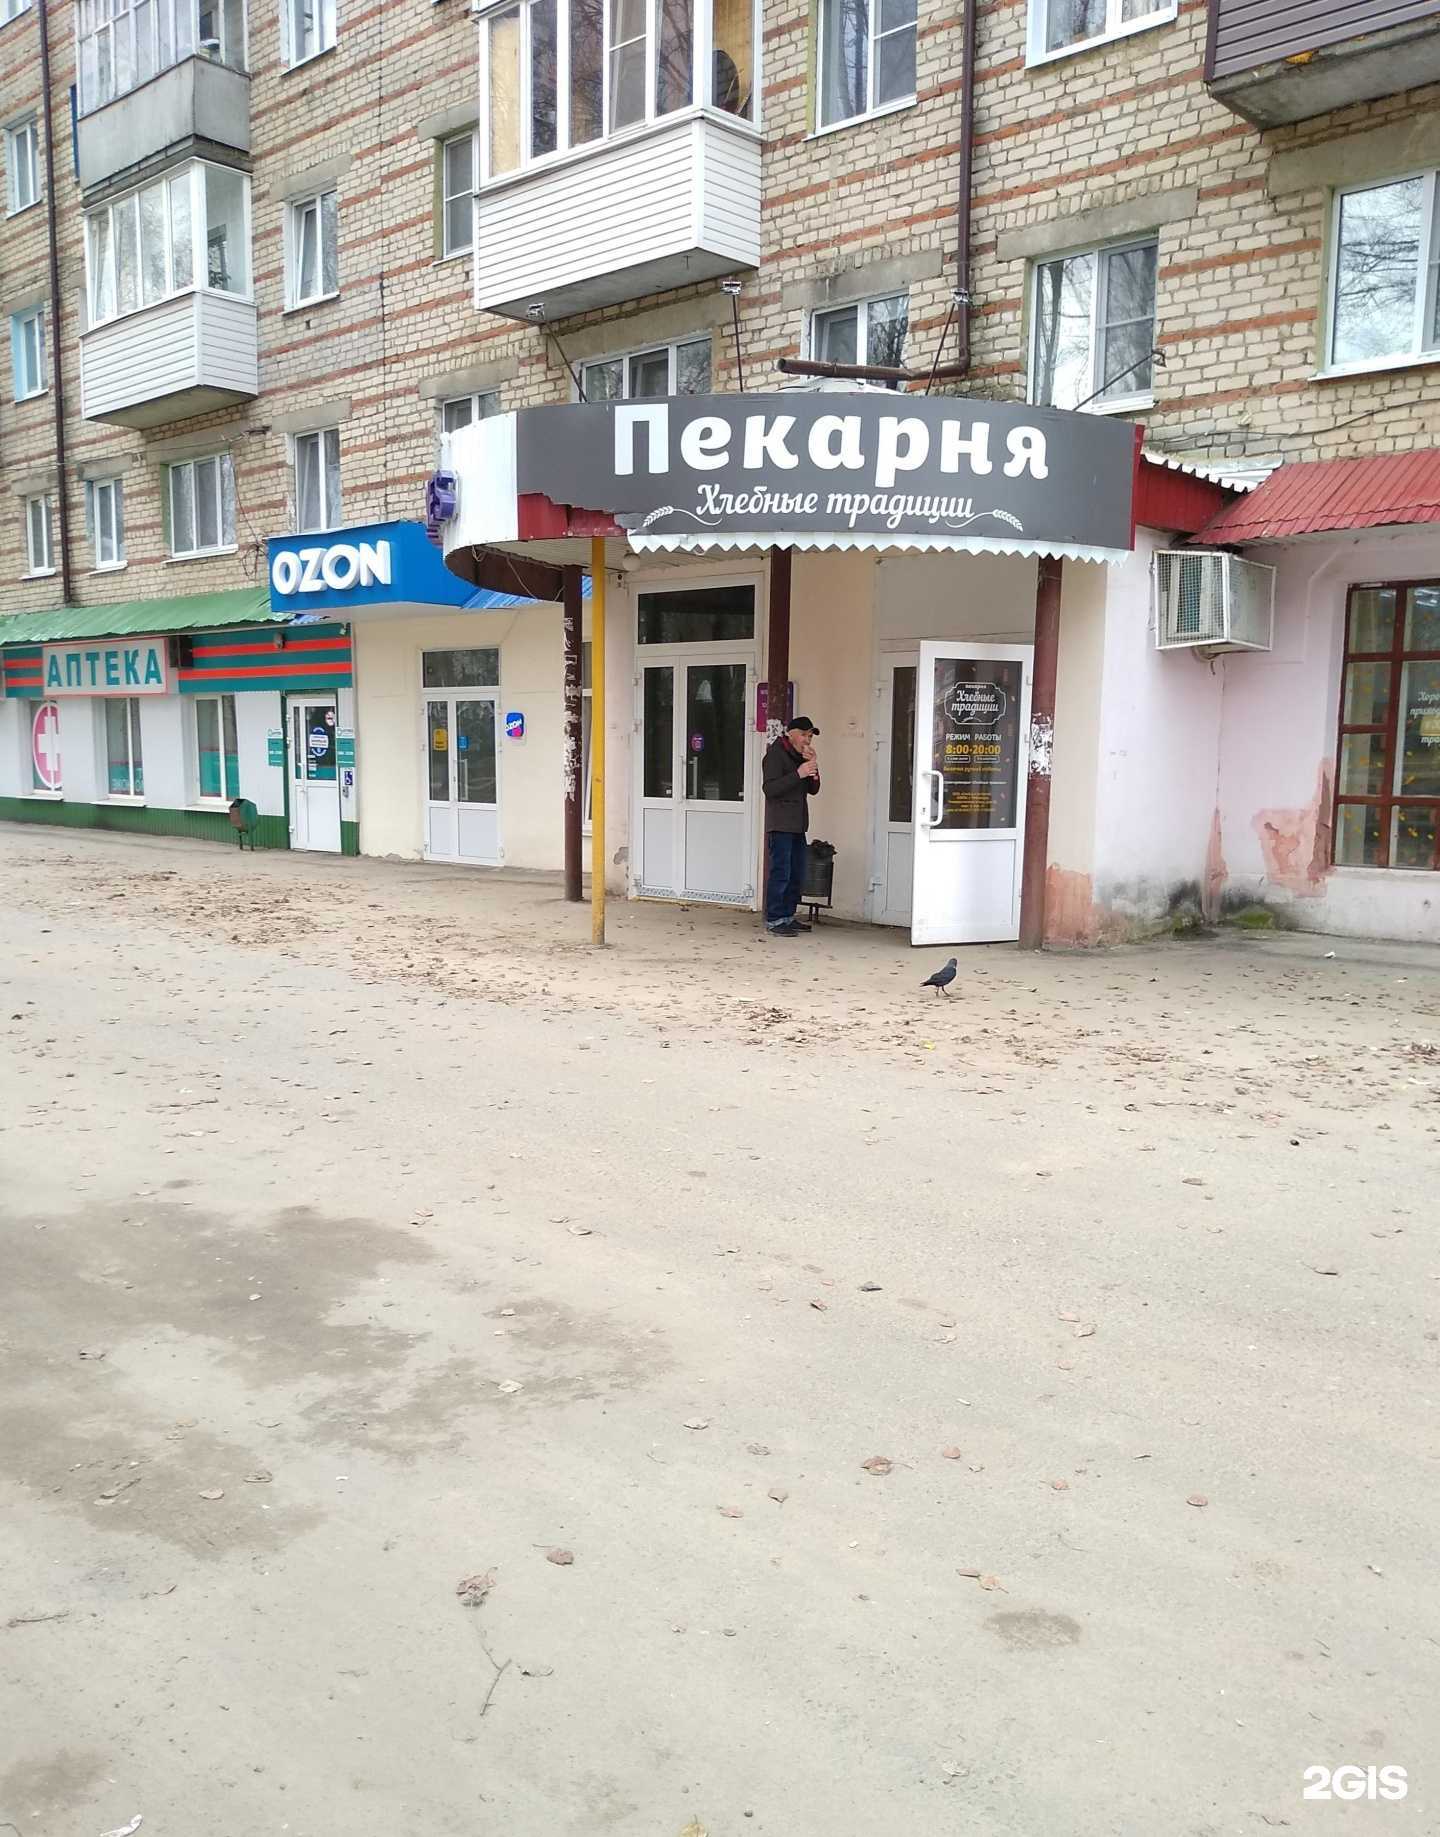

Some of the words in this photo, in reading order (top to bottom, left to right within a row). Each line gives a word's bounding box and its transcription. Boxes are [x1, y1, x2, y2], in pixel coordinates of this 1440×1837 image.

[614, 403, 1049, 488] Пекарня
[696, 483, 818, 515] Хлебные
[825, 492, 975, 529] традиции
[271, 540, 392, 596] OZON
[47, 647, 163, 688] АПТЕКА
[951, 703, 999, 716] традиции
[956, 690, 996, 703] Хлебные
[945, 733, 971, 741] РЕЖИМ
[974, 733, 1002, 741] РАБОТЫ
